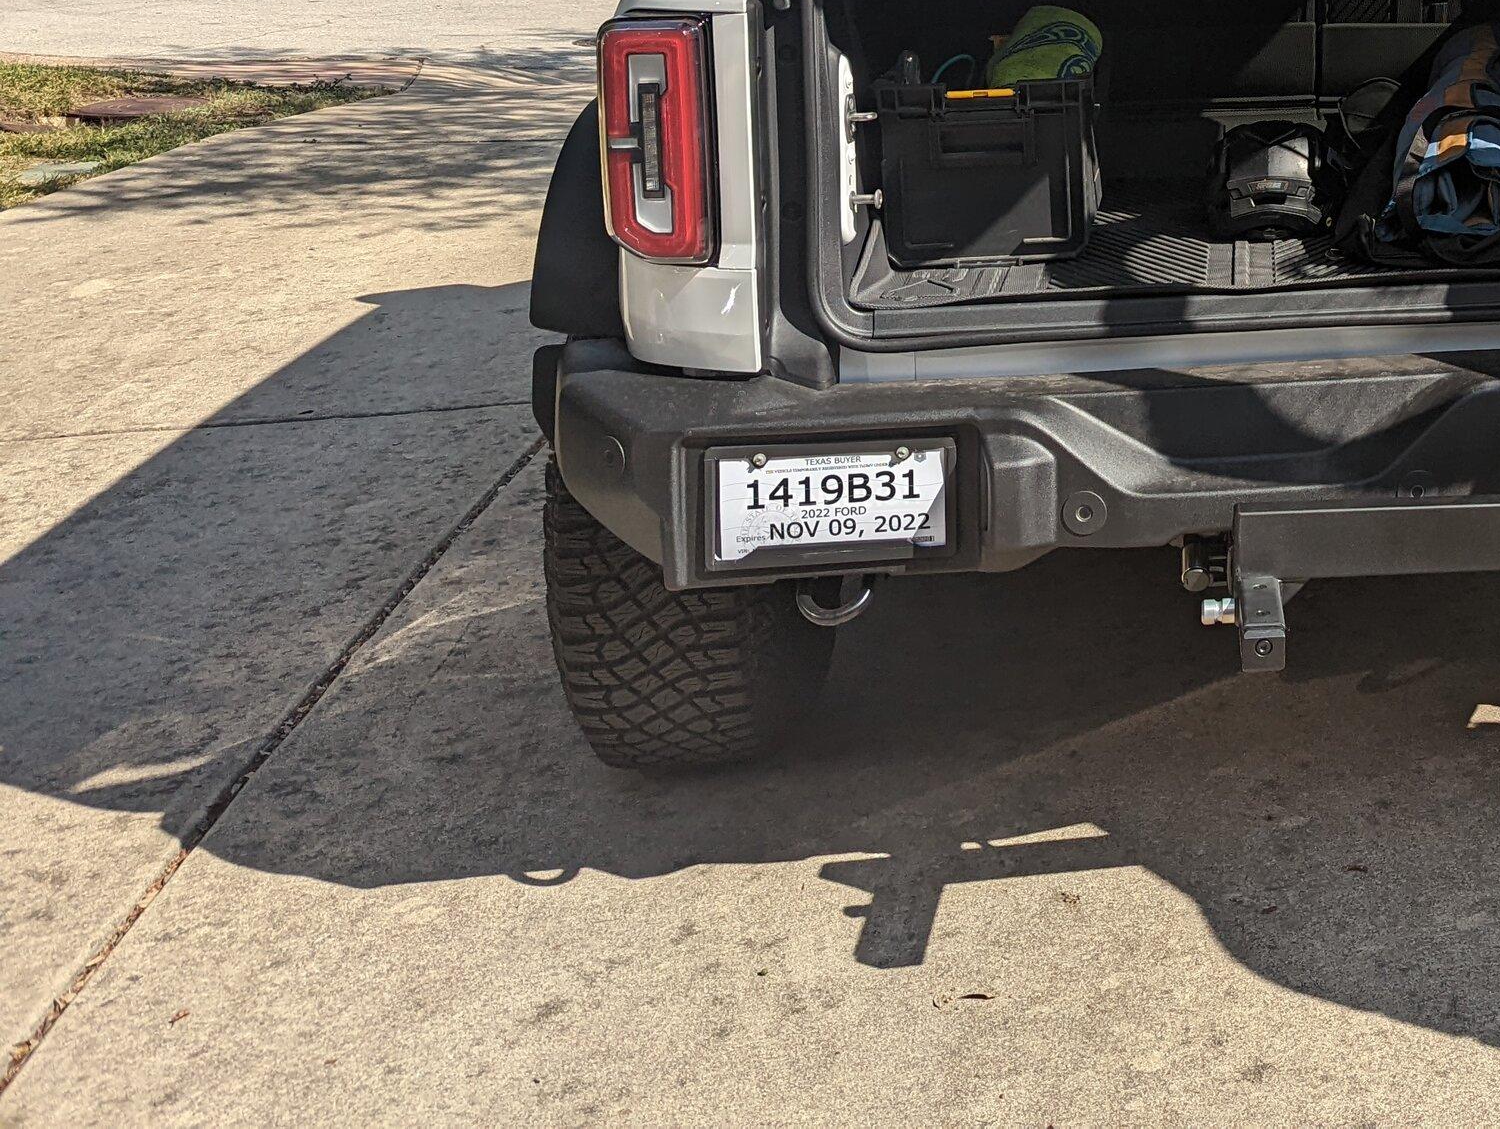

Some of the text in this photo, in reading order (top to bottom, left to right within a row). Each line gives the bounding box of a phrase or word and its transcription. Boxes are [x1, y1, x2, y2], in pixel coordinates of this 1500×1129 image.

[804, 457, 832, 467] TEXAS
[834, 455, 862, 465] BUYER
[746, 468, 921, 510] 1419B31
[801, 505, 867, 519] 2022 FORD
[735, 512, 931, 543] Expires NOV 09, 2022
